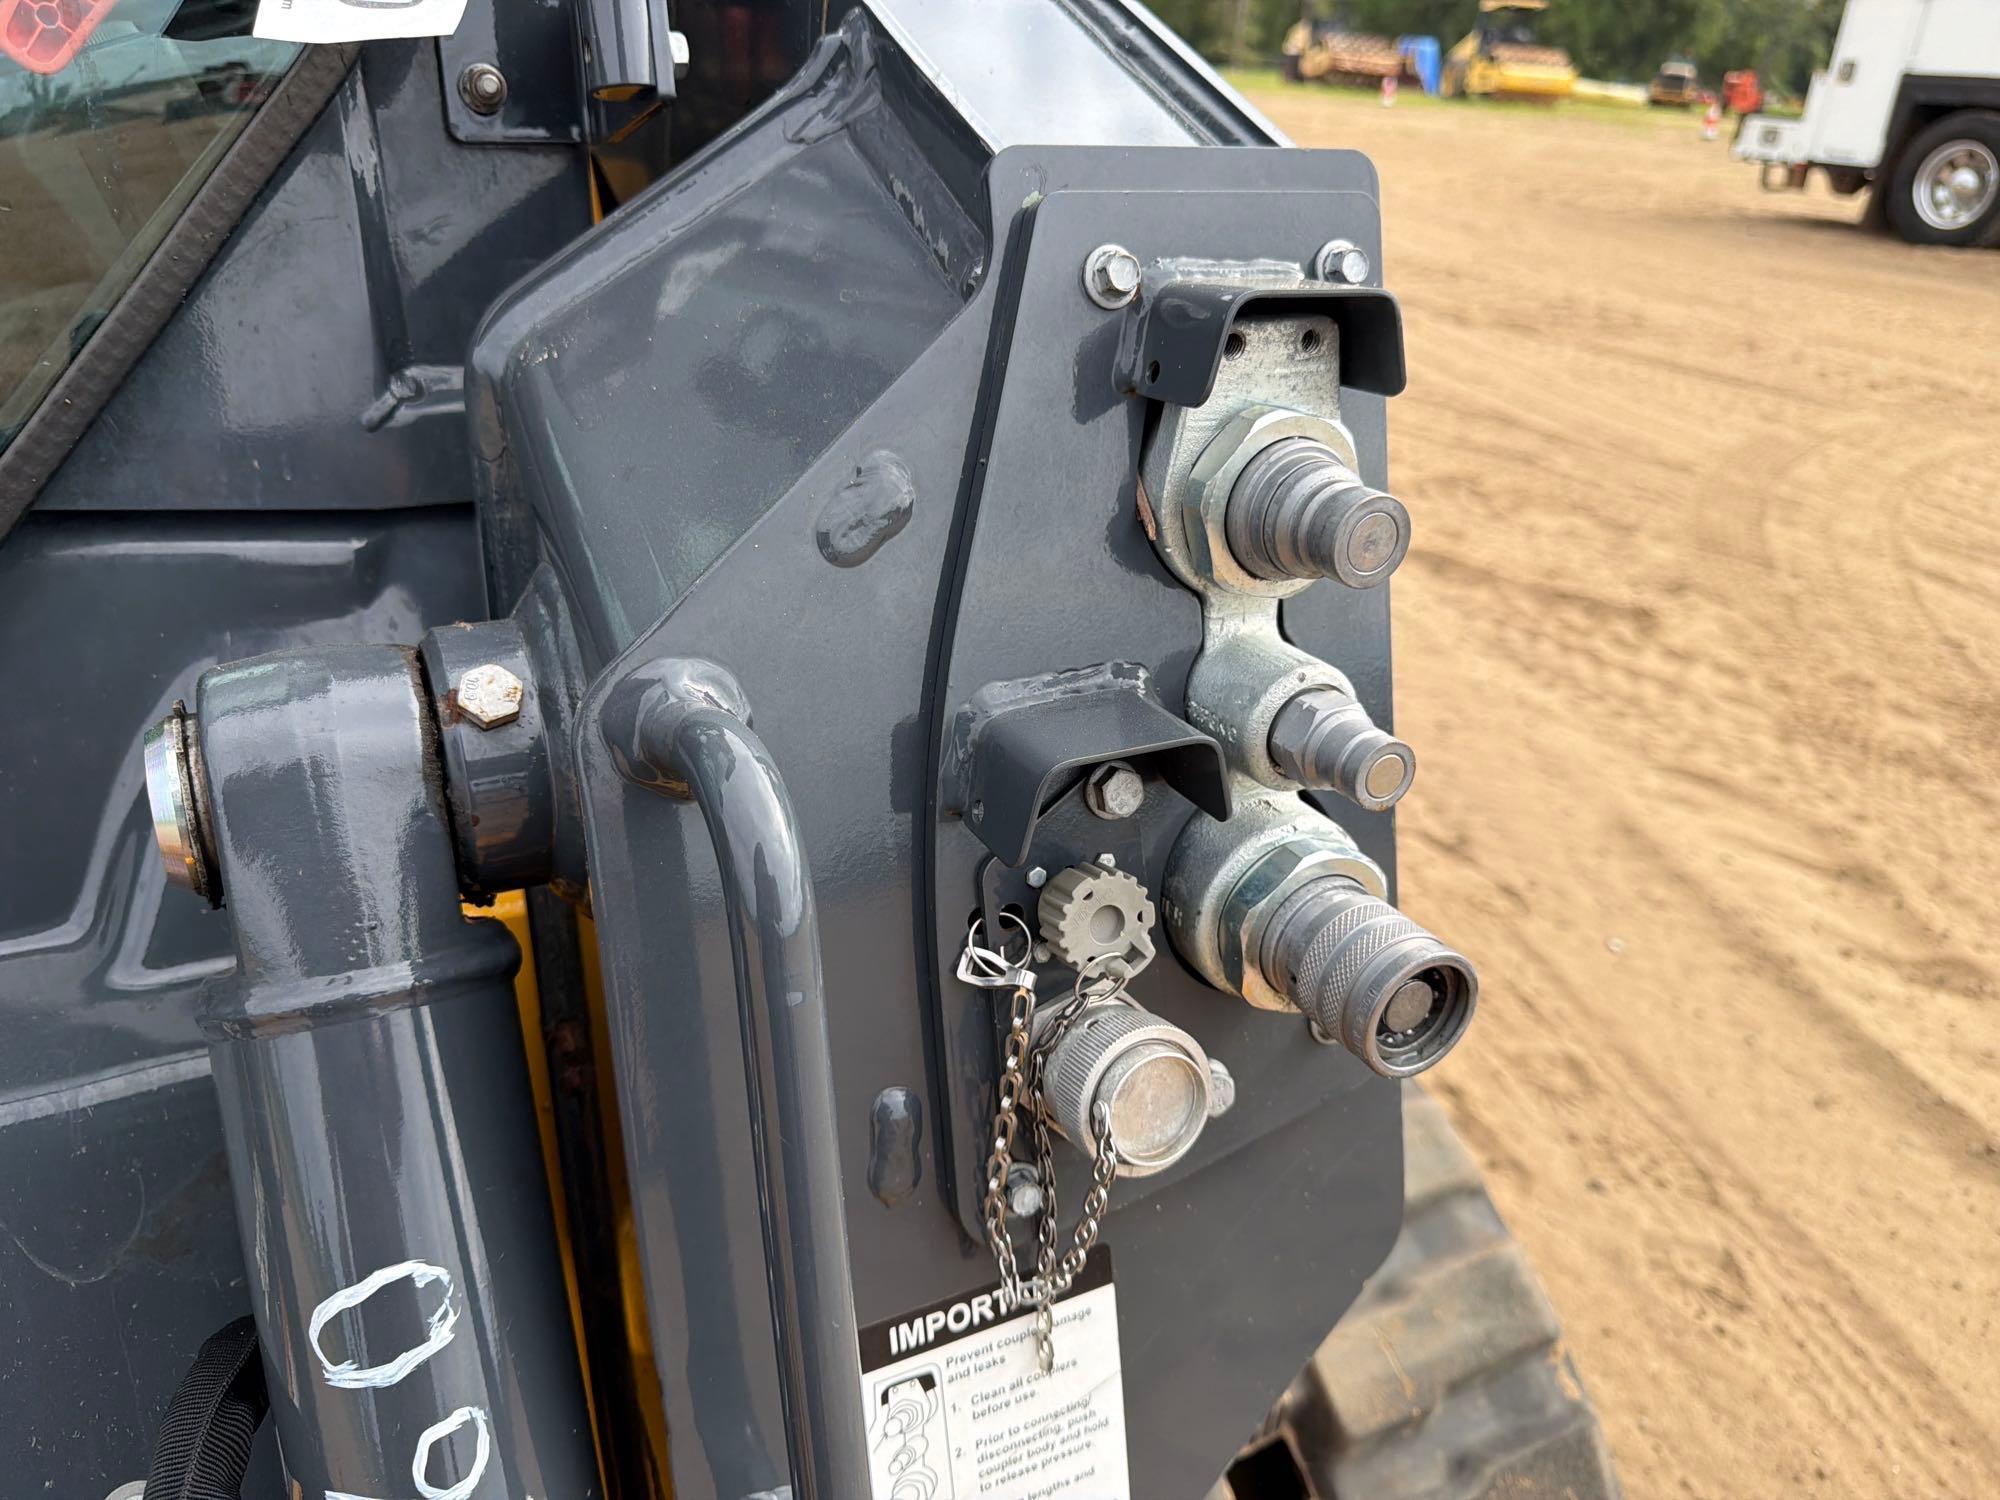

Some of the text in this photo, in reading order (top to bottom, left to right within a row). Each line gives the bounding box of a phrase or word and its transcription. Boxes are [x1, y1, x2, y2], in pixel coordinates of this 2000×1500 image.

[888, 1280, 1041, 1356] IMPORT
[946, 1343, 993, 1368] Prevent
[997, 1324, 1041, 1349] couple
[947, 1354, 1006, 1384] and leaks
[951, 1402, 961, 1413] 1.
[970, 1386, 1006, 1405] Clean
[1009, 1378, 1024, 1392] all
[972, 1390, 1039, 1421] before use.
[1067, 1408, 1097, 1430] push
[955, 1447, 966, 1459] 2.
[975, 1432, 1005, 1449] Prior
[1008, 1425, 1021, 1437] to
[977, 1416, 1110, 1479] coupler body and hold
[979, 1480, 992, 1494] to
[995, 1463, 1038, 1486] release
[1074, 1465, 1096, 1482] and
